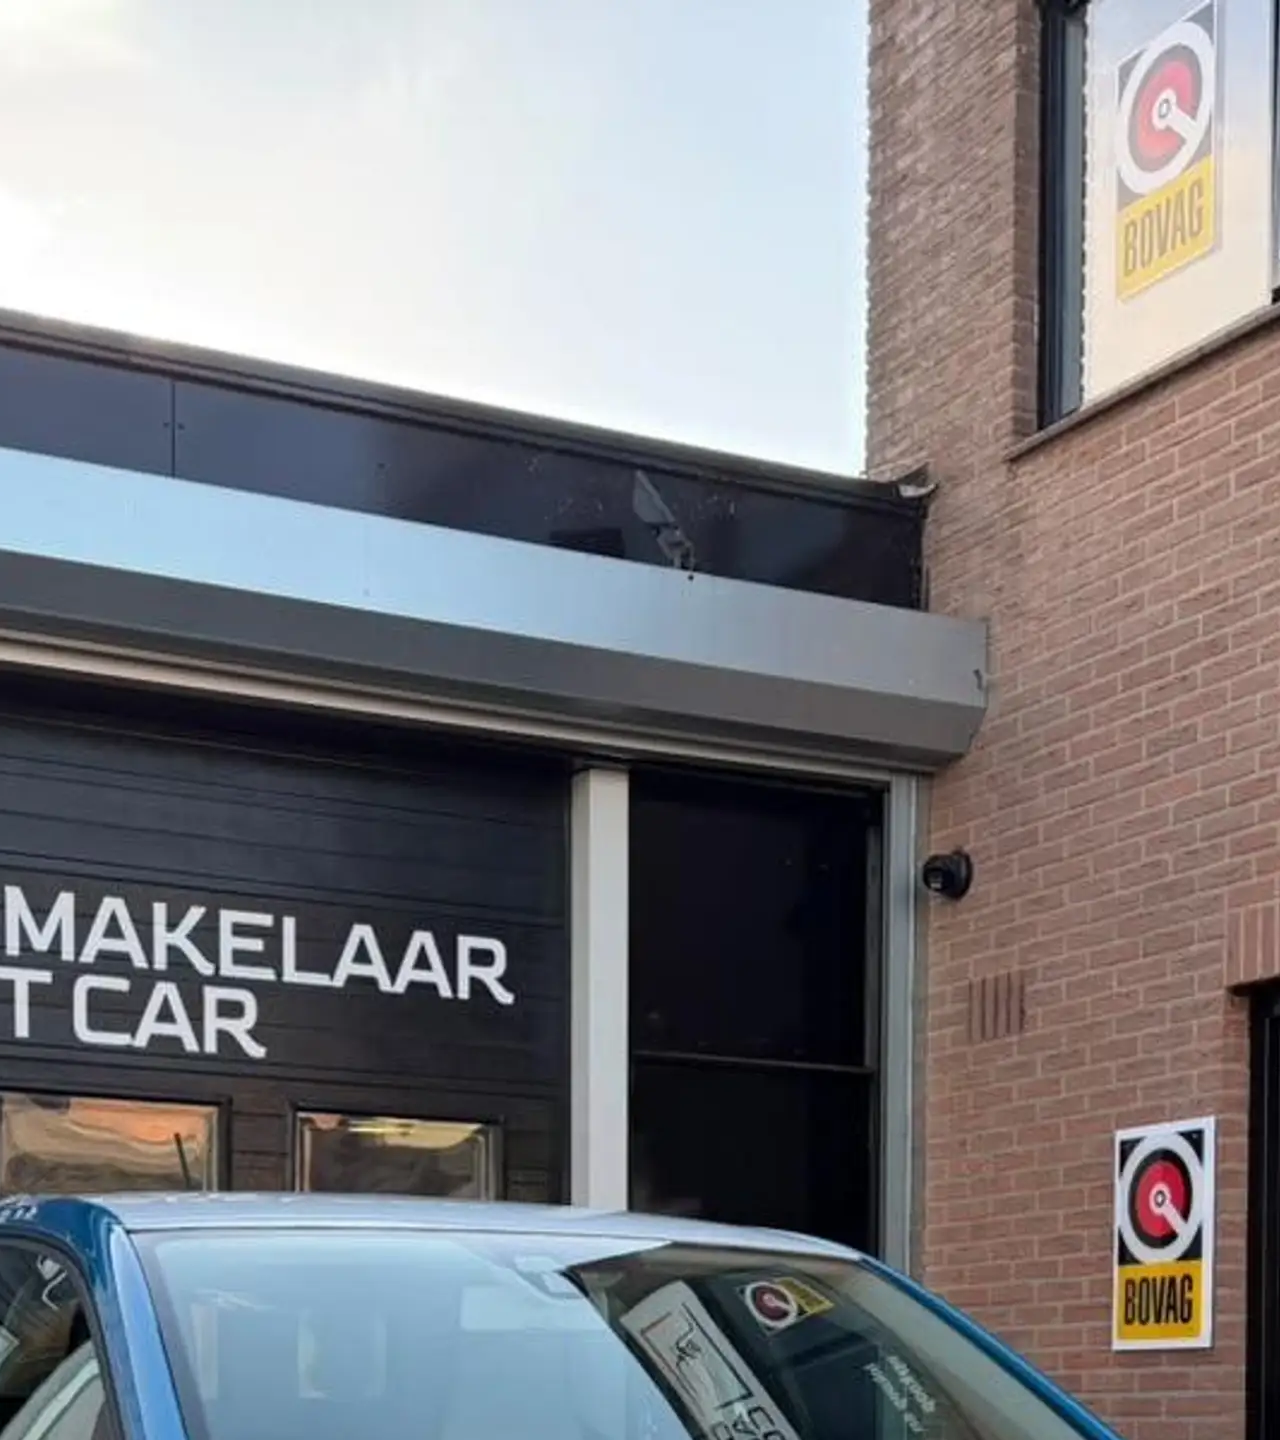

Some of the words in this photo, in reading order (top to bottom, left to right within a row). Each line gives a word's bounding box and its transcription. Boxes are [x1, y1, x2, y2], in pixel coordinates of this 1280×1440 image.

[1123, 176, 1205, 279] BOVAG
[73, 974, 268, 1059] CAR
[1124, 1273, 1194, 1326] BOVAG
